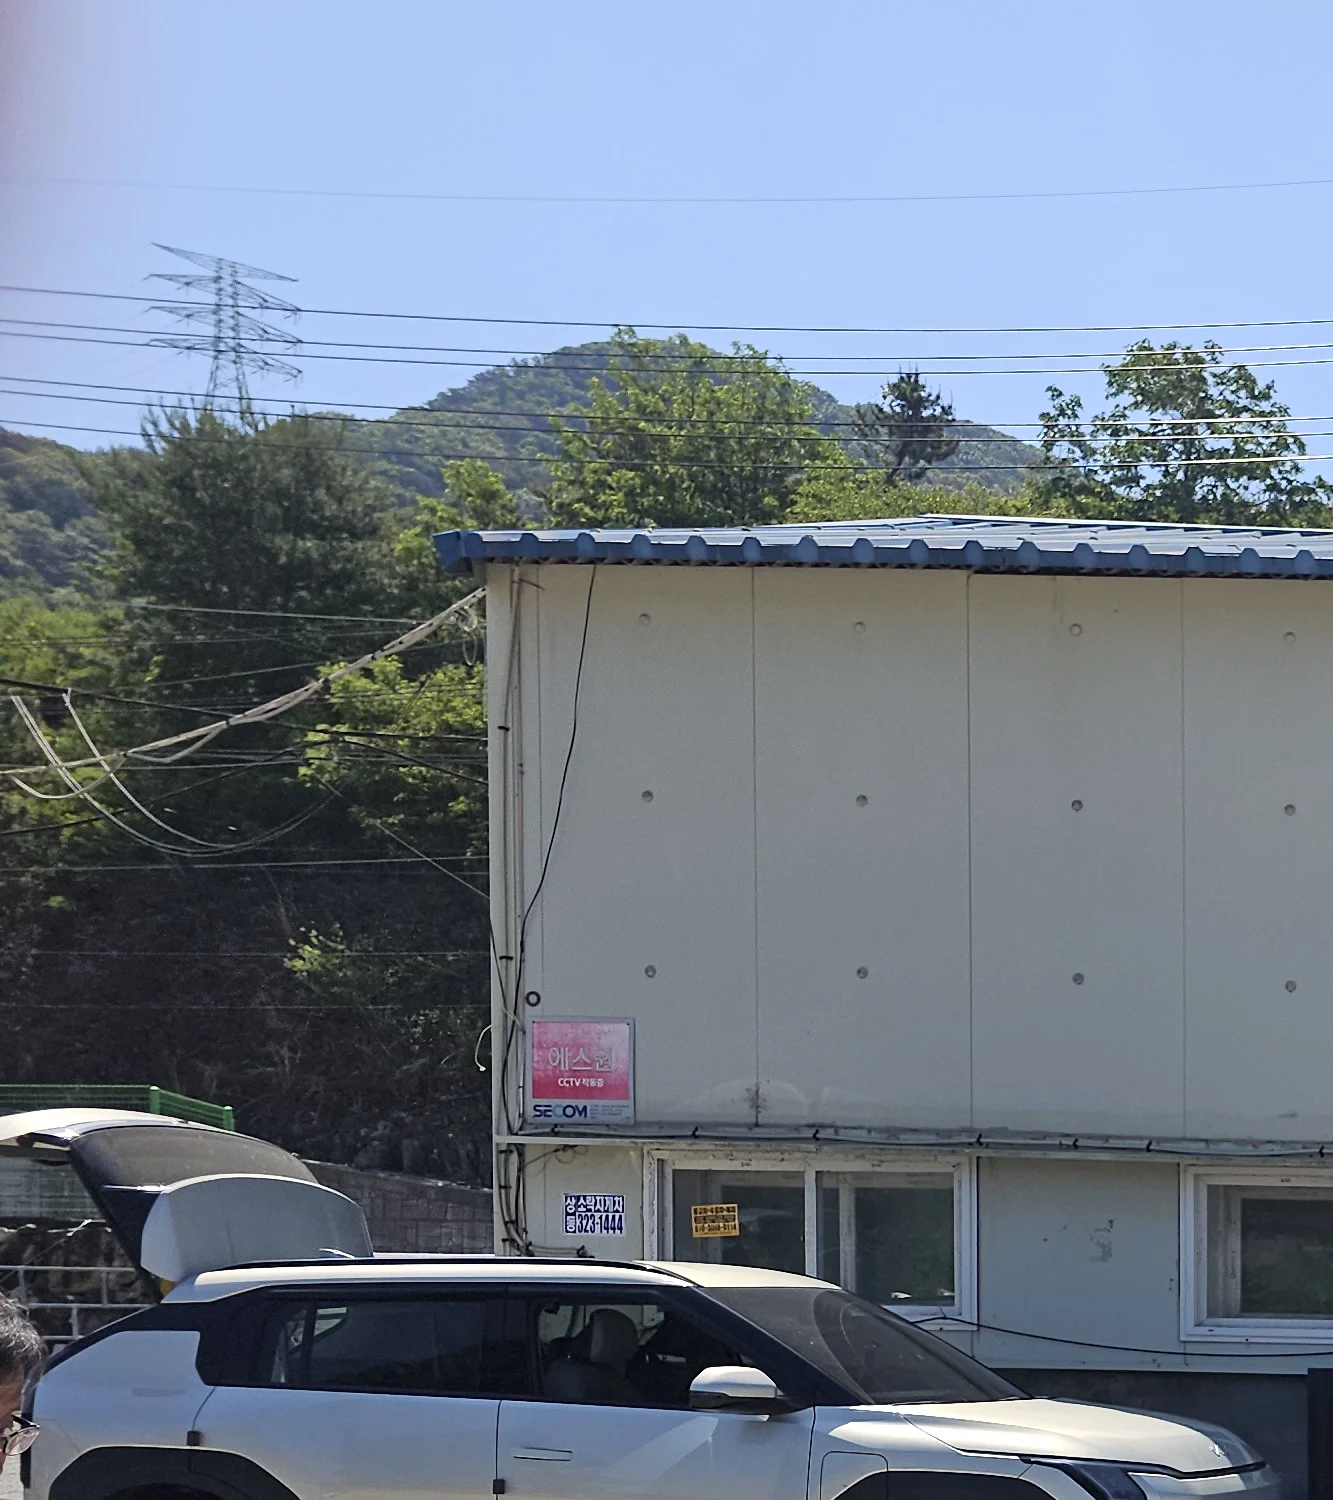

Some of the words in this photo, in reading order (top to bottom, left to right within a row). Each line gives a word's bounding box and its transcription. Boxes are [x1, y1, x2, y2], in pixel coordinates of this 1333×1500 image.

[548, 1047, 613, 1073] 에스원
[558, 1077, 581, 1087] CCTV
[533, 1104, 588, 1118] SECOM
[577, 1213, 623, 1235] 323-1444
